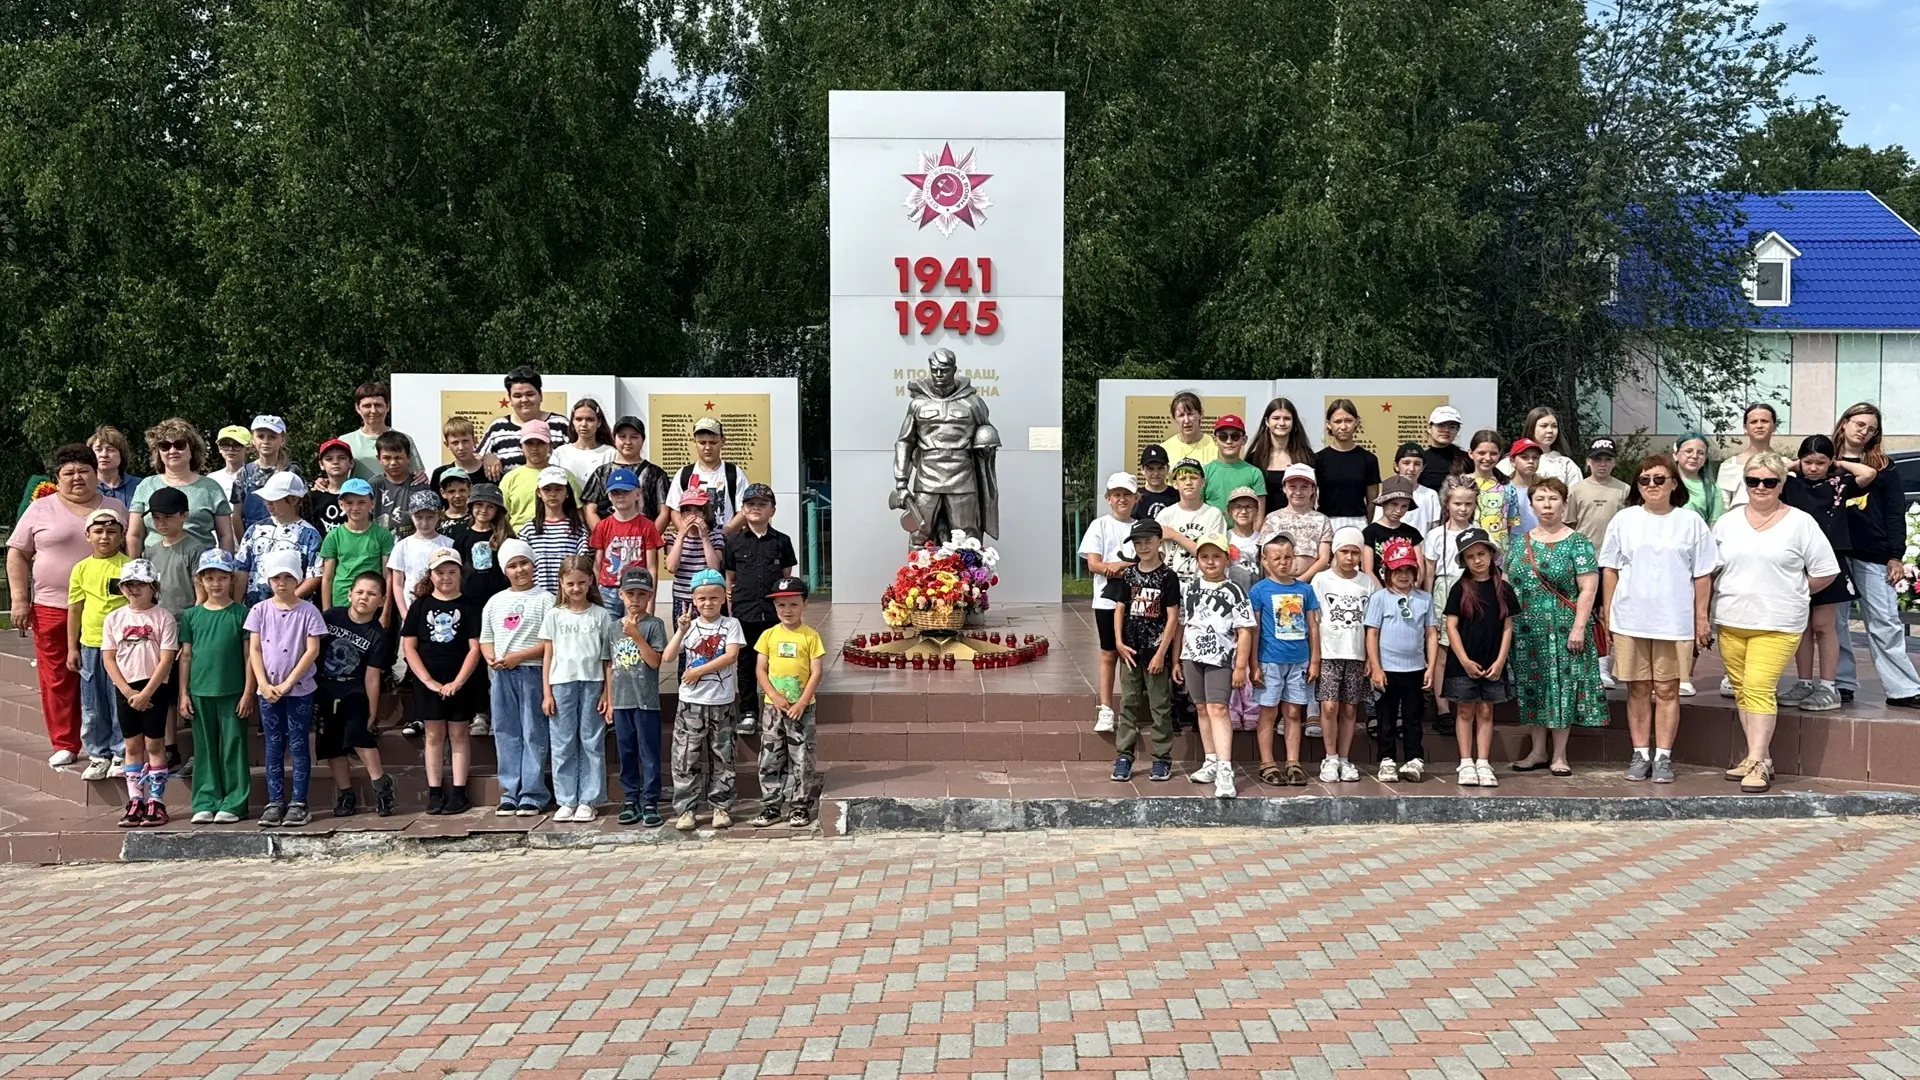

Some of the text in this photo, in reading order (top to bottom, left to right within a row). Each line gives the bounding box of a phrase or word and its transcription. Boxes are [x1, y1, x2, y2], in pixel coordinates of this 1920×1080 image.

[894, 256, 991, 294] 1941
[894, 300, 999, 336] 1945
[893, 368, 903, 380] И
[964, 368, 1000, 382] ВАШ,
[895, 386, 905, 397] И
